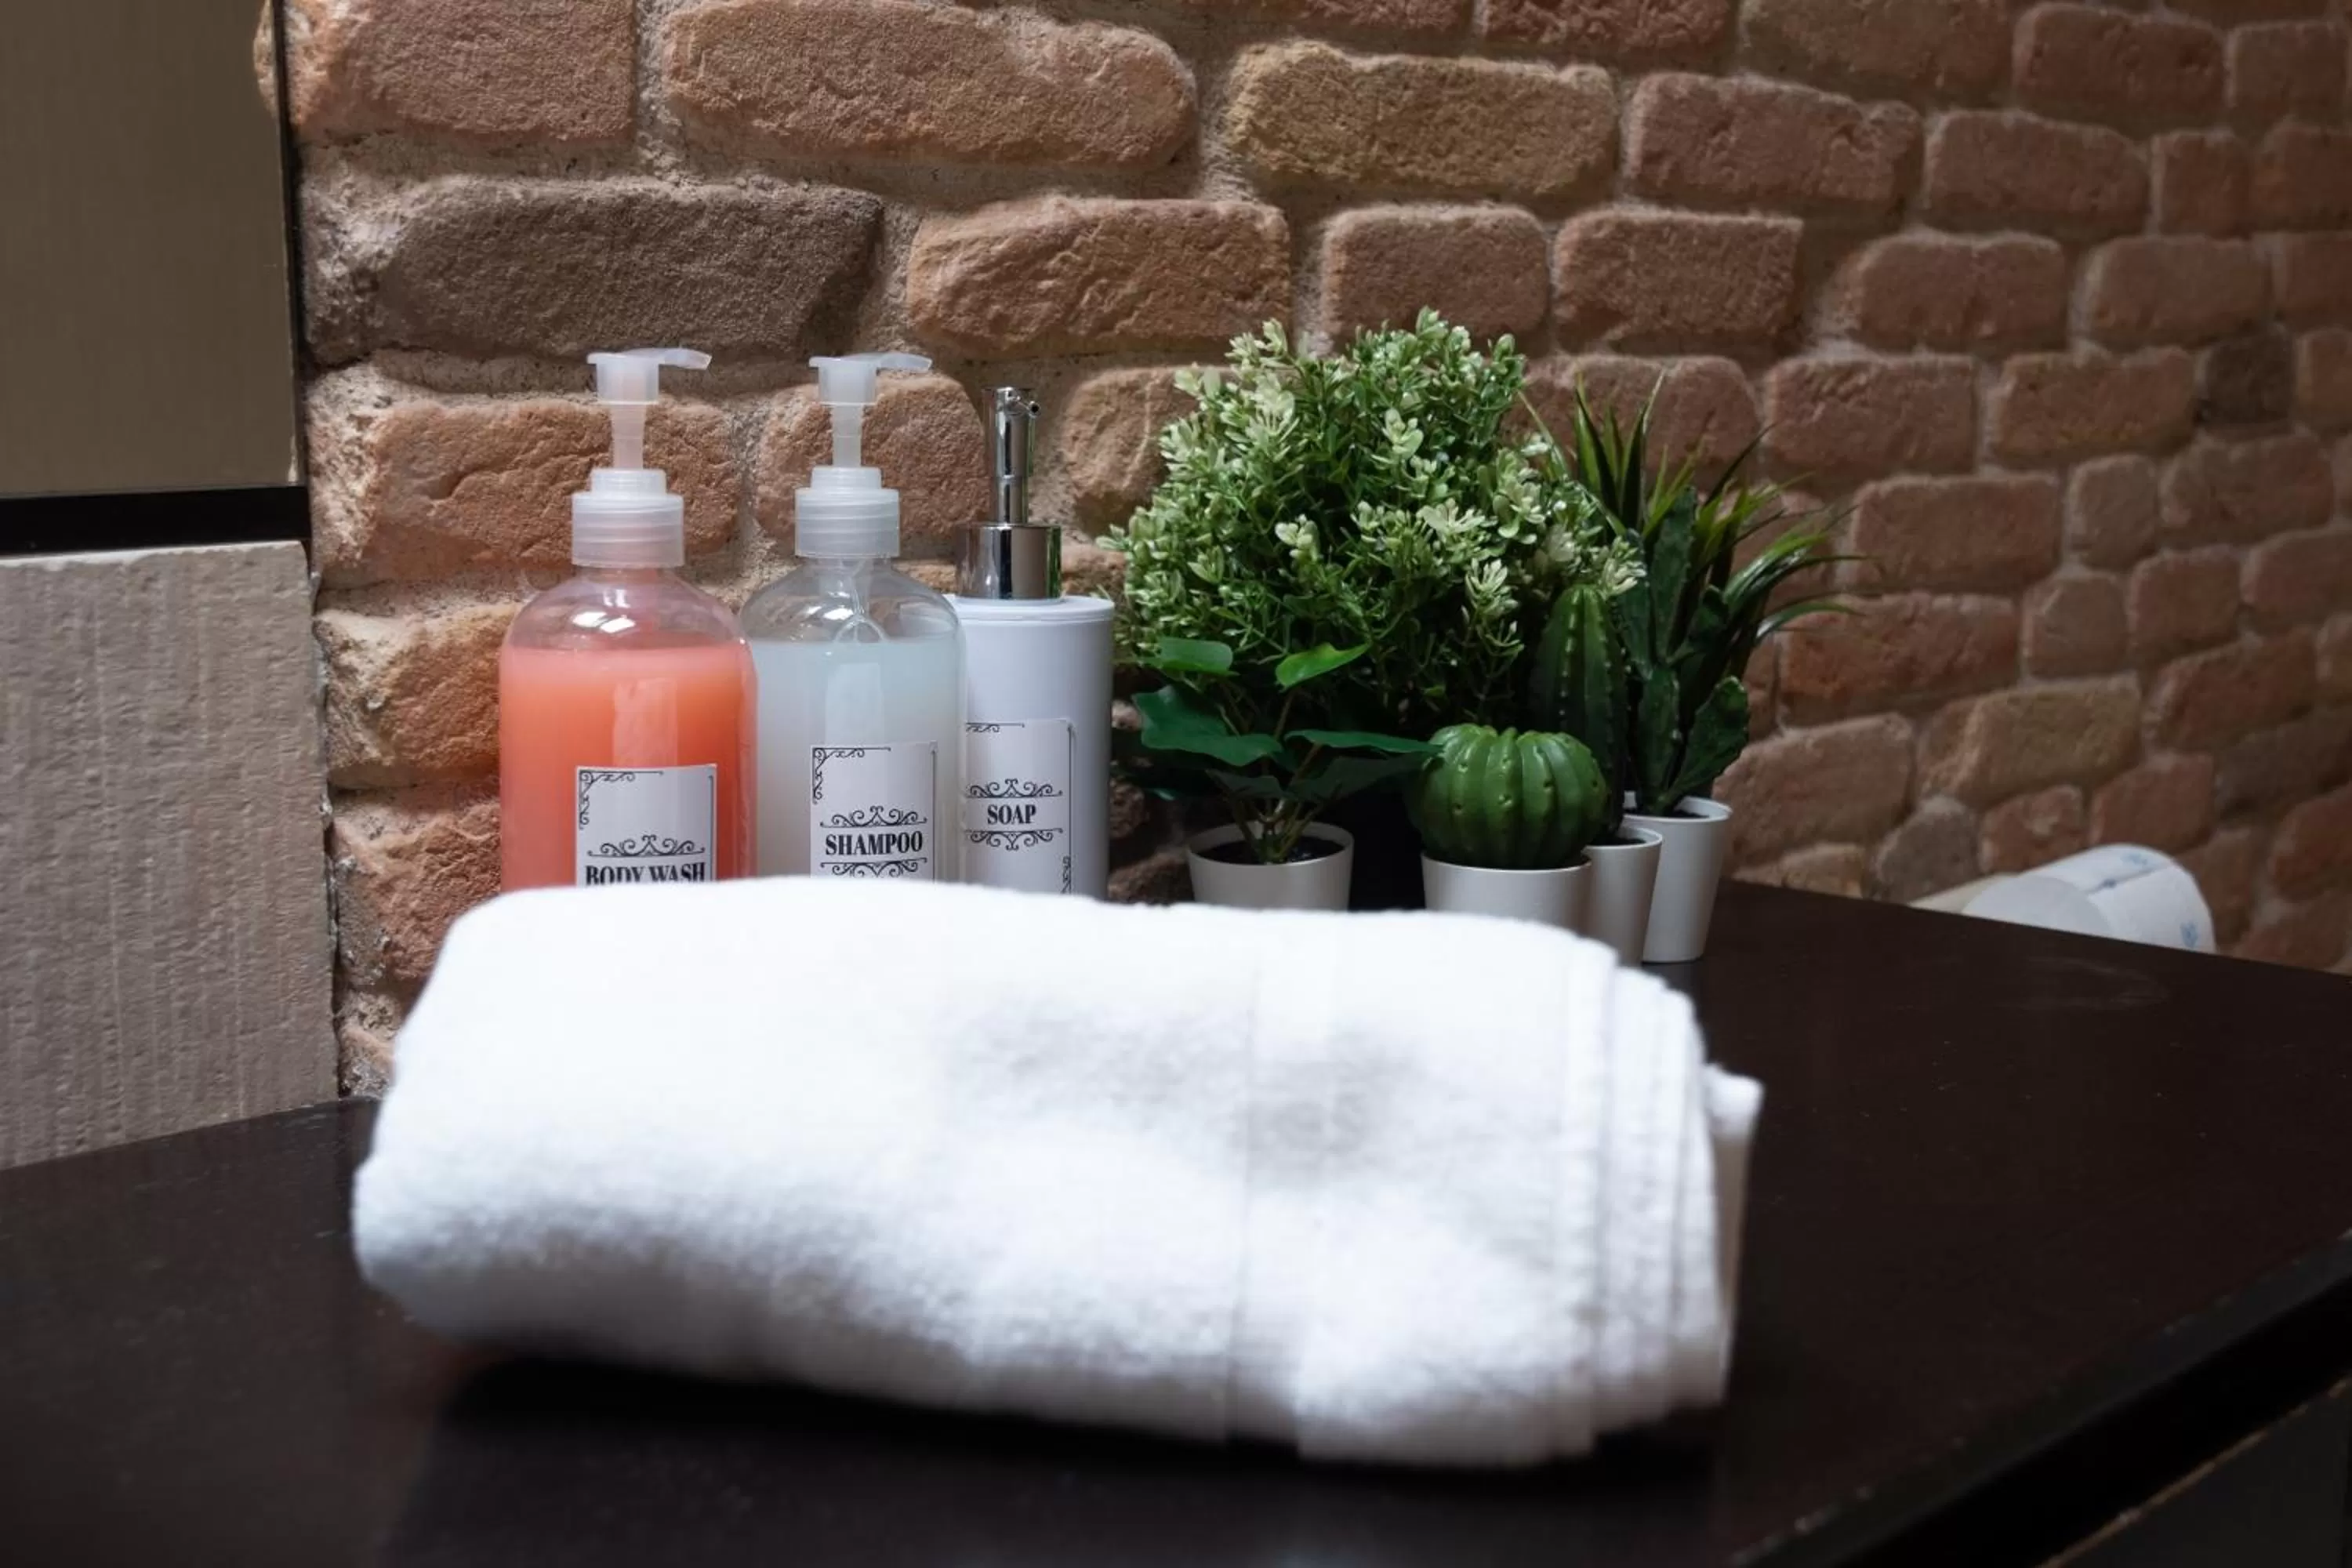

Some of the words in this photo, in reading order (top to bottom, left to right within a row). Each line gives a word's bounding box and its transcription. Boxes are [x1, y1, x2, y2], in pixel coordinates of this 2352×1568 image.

[987, 804, 1036, 825] SOAP
[825, 830, 923, 855] SHAMPOO
[586, 865, 644, 885] BODY
[648, 862, 706, 883] WASH
